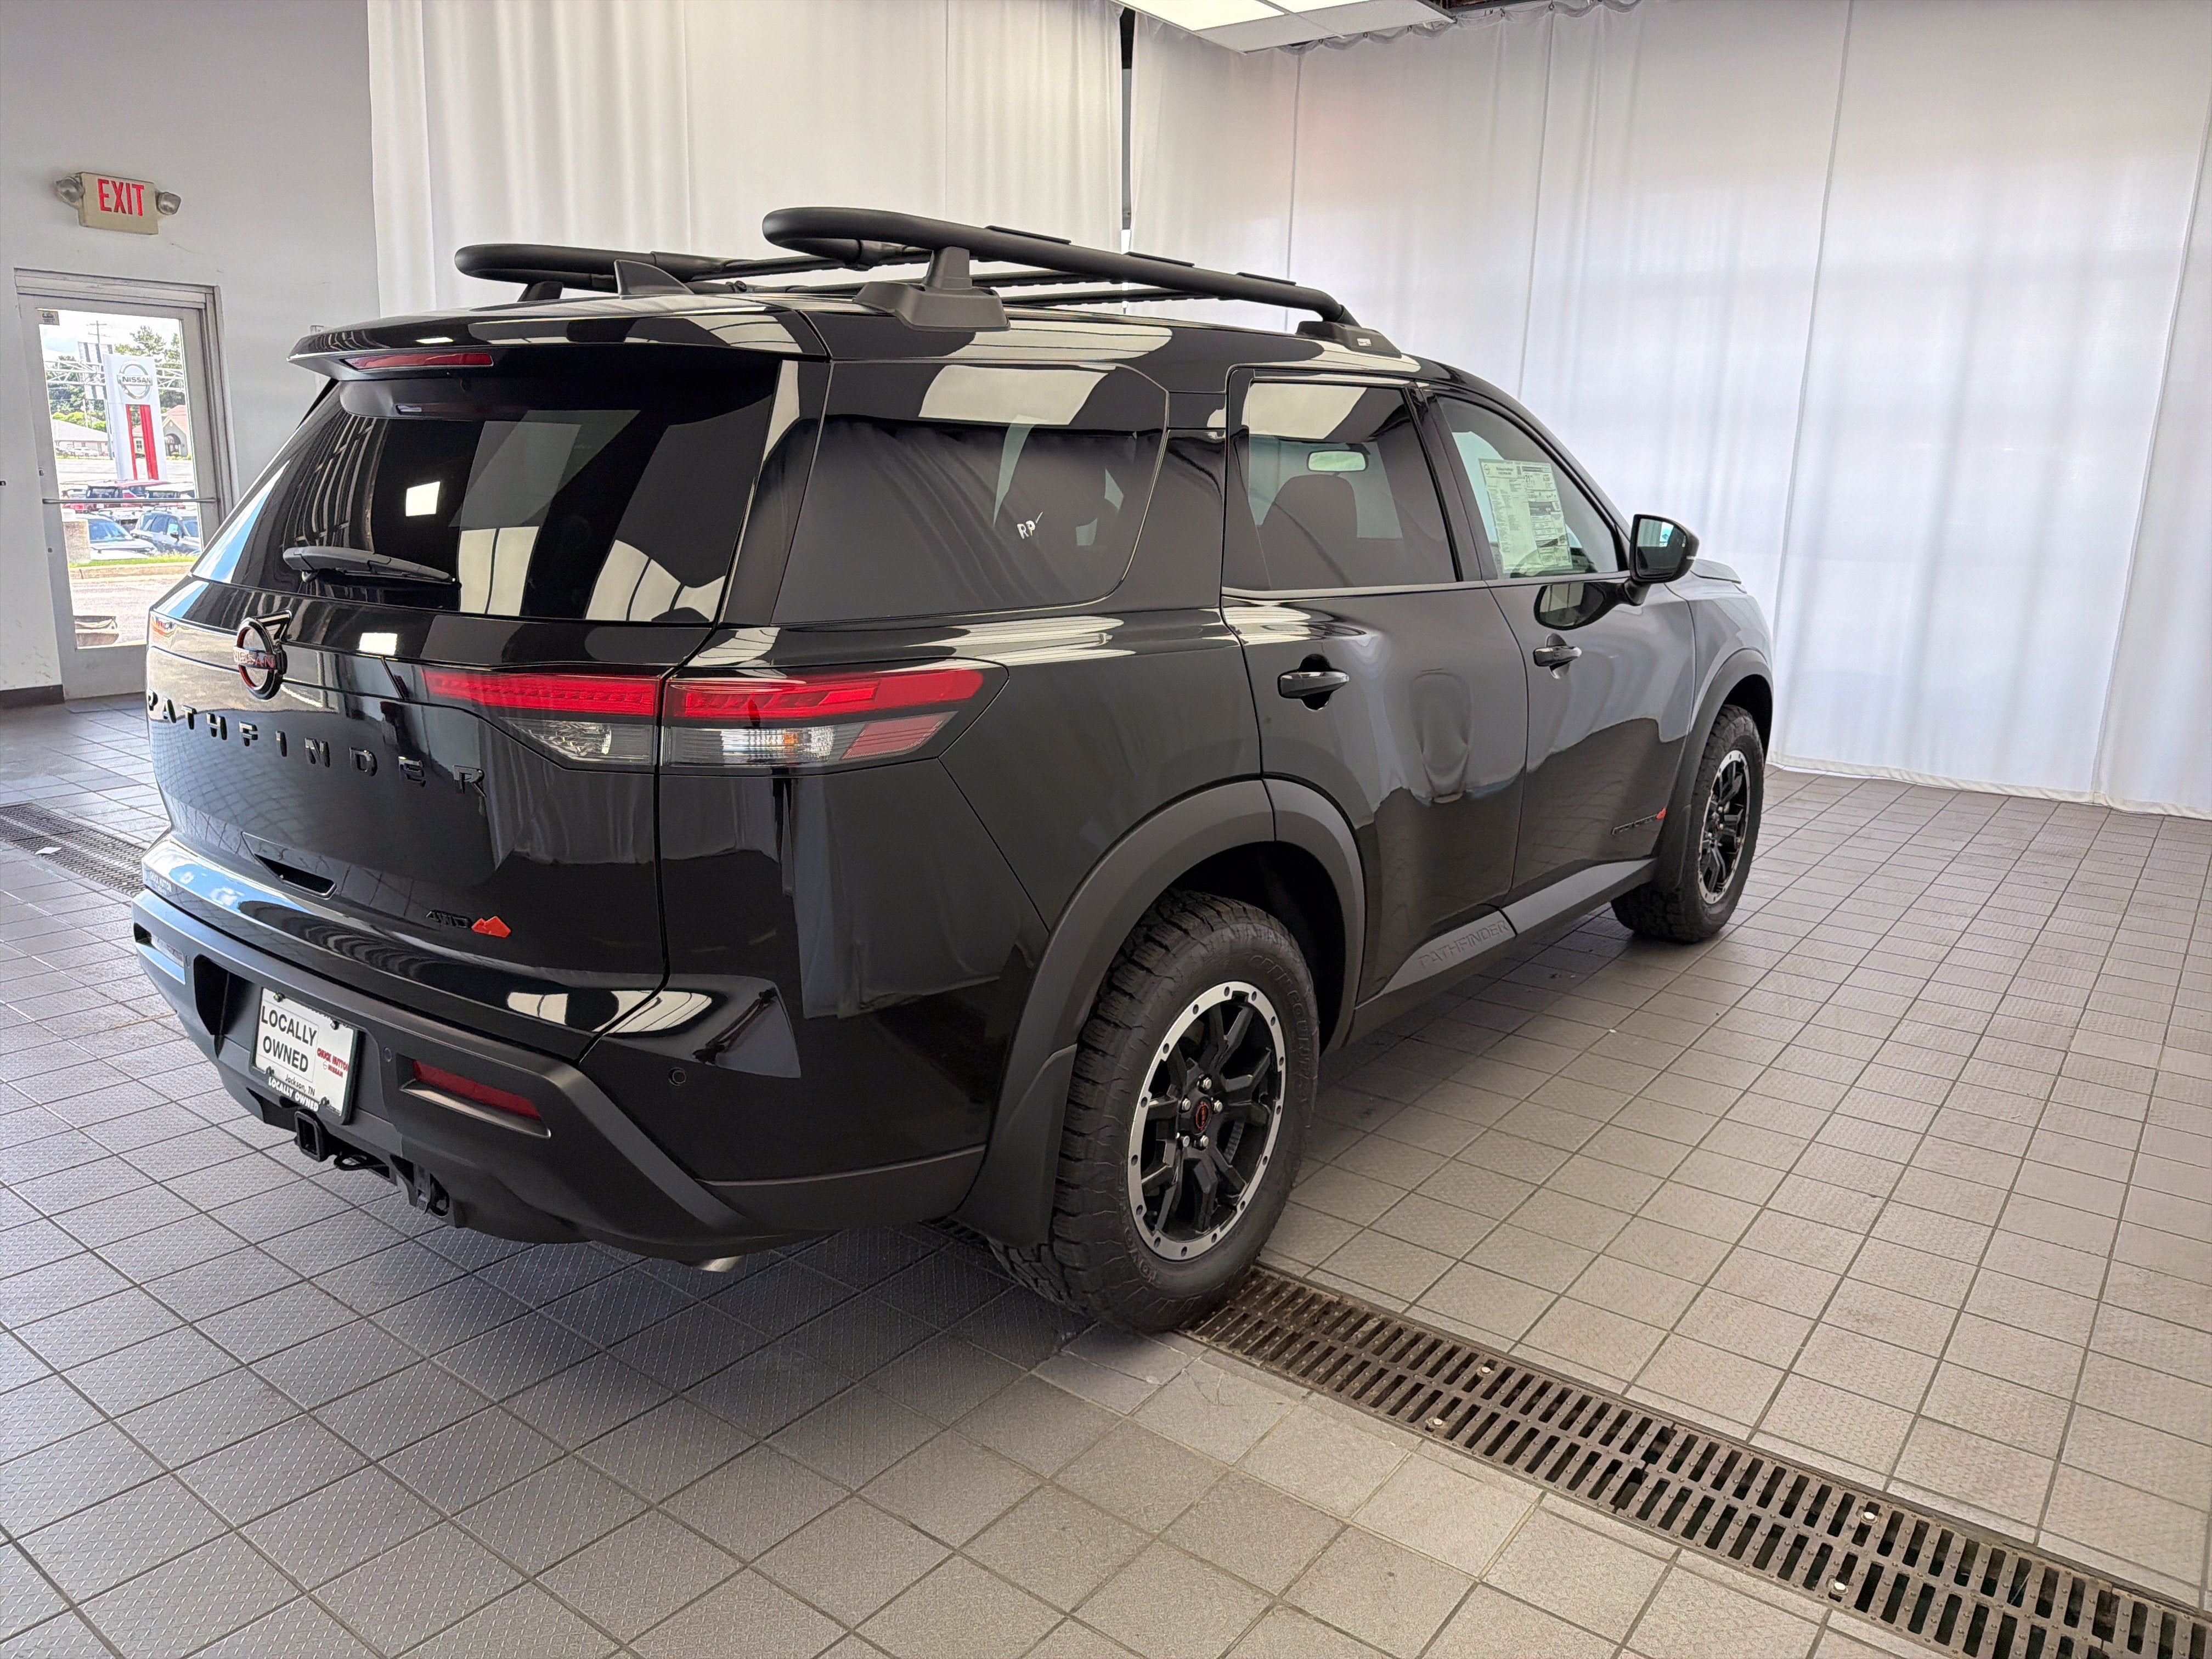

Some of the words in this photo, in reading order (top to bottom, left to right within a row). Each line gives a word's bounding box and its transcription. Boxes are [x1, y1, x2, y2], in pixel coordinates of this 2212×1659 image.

[98, 178, 144, 217] EXIT
[233, 649, 275, 668] NISSAN
[146, 689, 487, 797] PATHFINDER
[1417, 920, 1510, 968] PATHFINDER
[261, 1005, 317, 1046] LOCALLY
[263, 1035, 308, 1073] OWNED
[268, 1077, 294, 1098] LOCALLY
[295, 1092, 319, 1111] OWNED
[285, 1074, 307, 1092] Jackson,
[308, 1085, 315, 1096] TN
